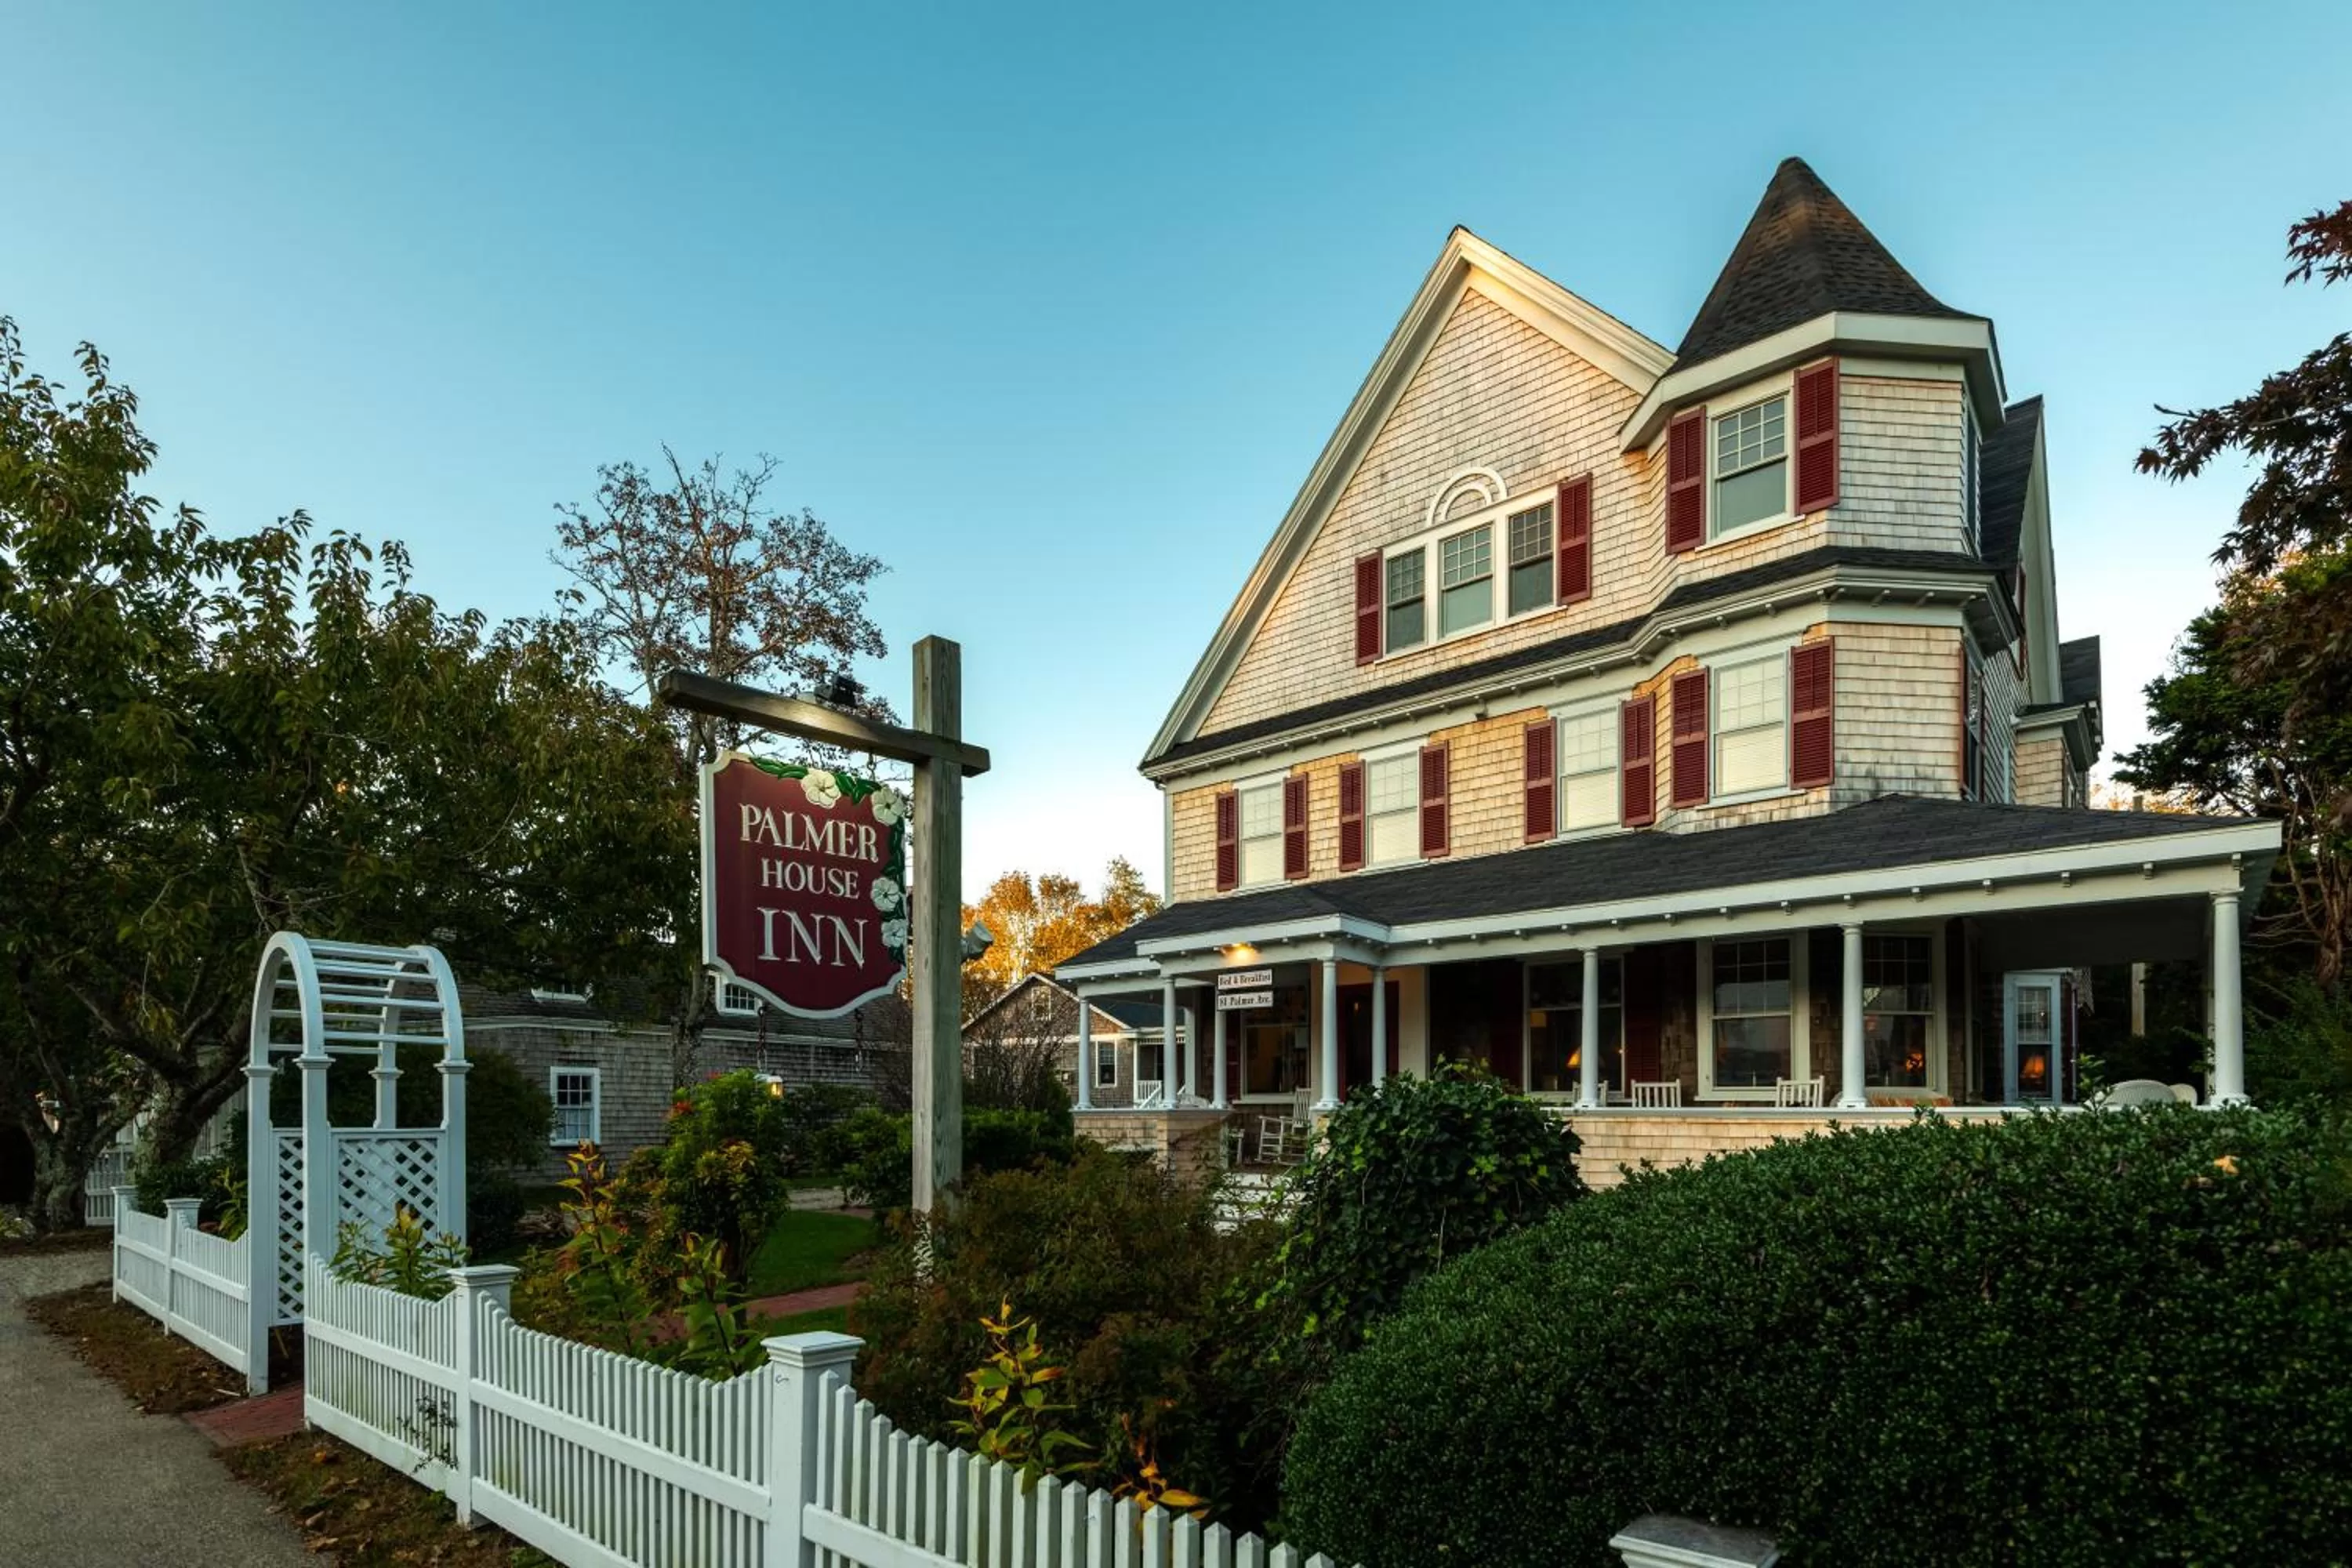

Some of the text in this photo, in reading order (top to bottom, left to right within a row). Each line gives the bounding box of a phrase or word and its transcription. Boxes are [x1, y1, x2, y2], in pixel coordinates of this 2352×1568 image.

[739, 804, 879, 862] PALMER
[760, 858, 860, 900] HOUSE
[757, 907, 869, 969] INN
[1219, 975, 1232, 985] Bed
[1240, 974, 1271, 984] Breakfast
[1230, 996, 1254, 1006] Palmer
